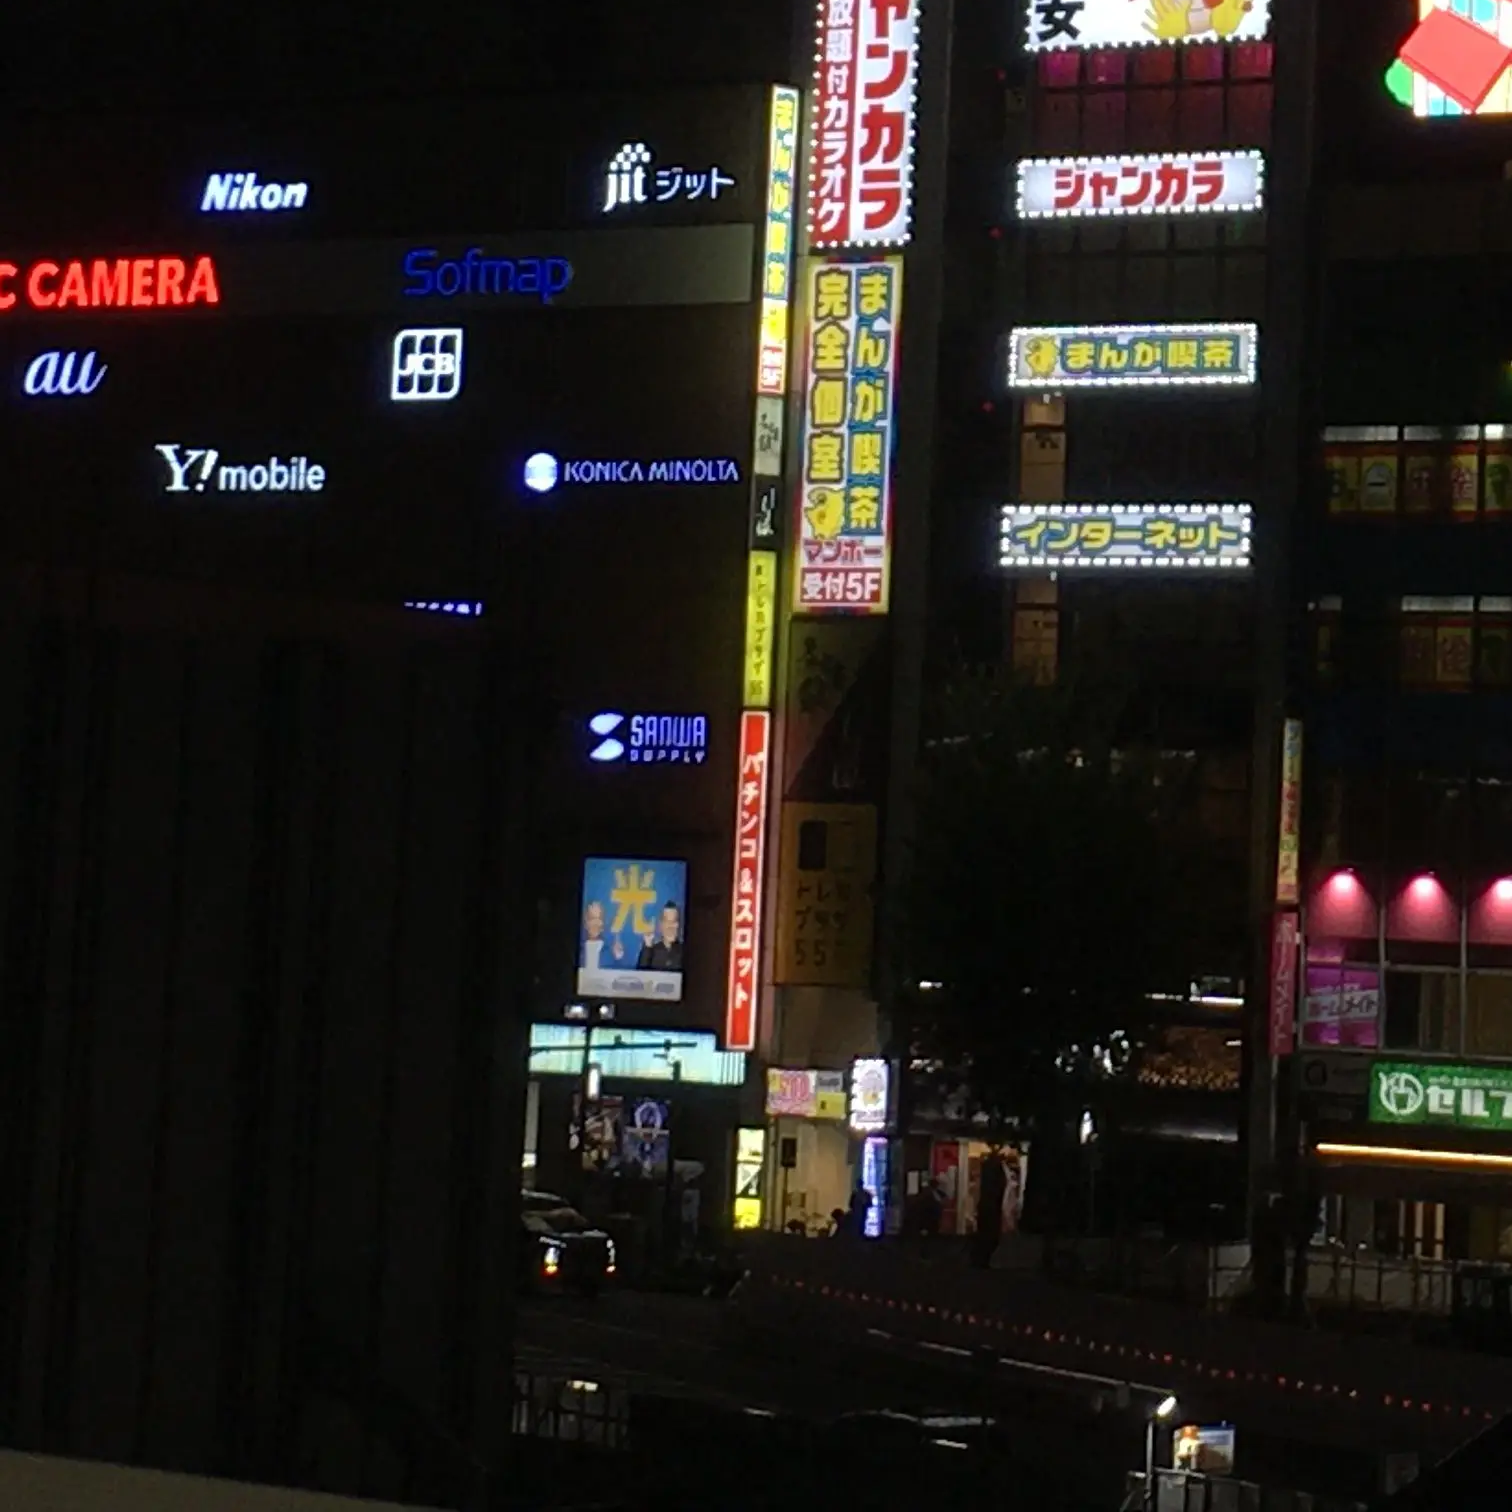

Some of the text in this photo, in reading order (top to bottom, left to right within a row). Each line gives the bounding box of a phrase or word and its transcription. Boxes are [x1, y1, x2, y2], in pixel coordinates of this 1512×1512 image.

[201, 173, 308, 211] Nikon
[603, 160, 649, 212] jit
[656, 167, 735, 201] ジット
[1054, 161, 1225, 209] ジャンカラ
[28, 257, 219, 308] CAMERA
[403, 248, 574, 305] Sofmap
[24, 351, 108, 395] au
[1065, 339, 1234, 370] まんが喫茶
[849, 273, 890, 531] まんが喫茶
[564, 459, 739, 482] KONICA MINOLTA
[1015, 520, 1238, 550] インターネット
[803, 571, 881, 601] 受付5F
[630, 715, 705, 747] SANWA
[610, 864, 657, 935] 光
